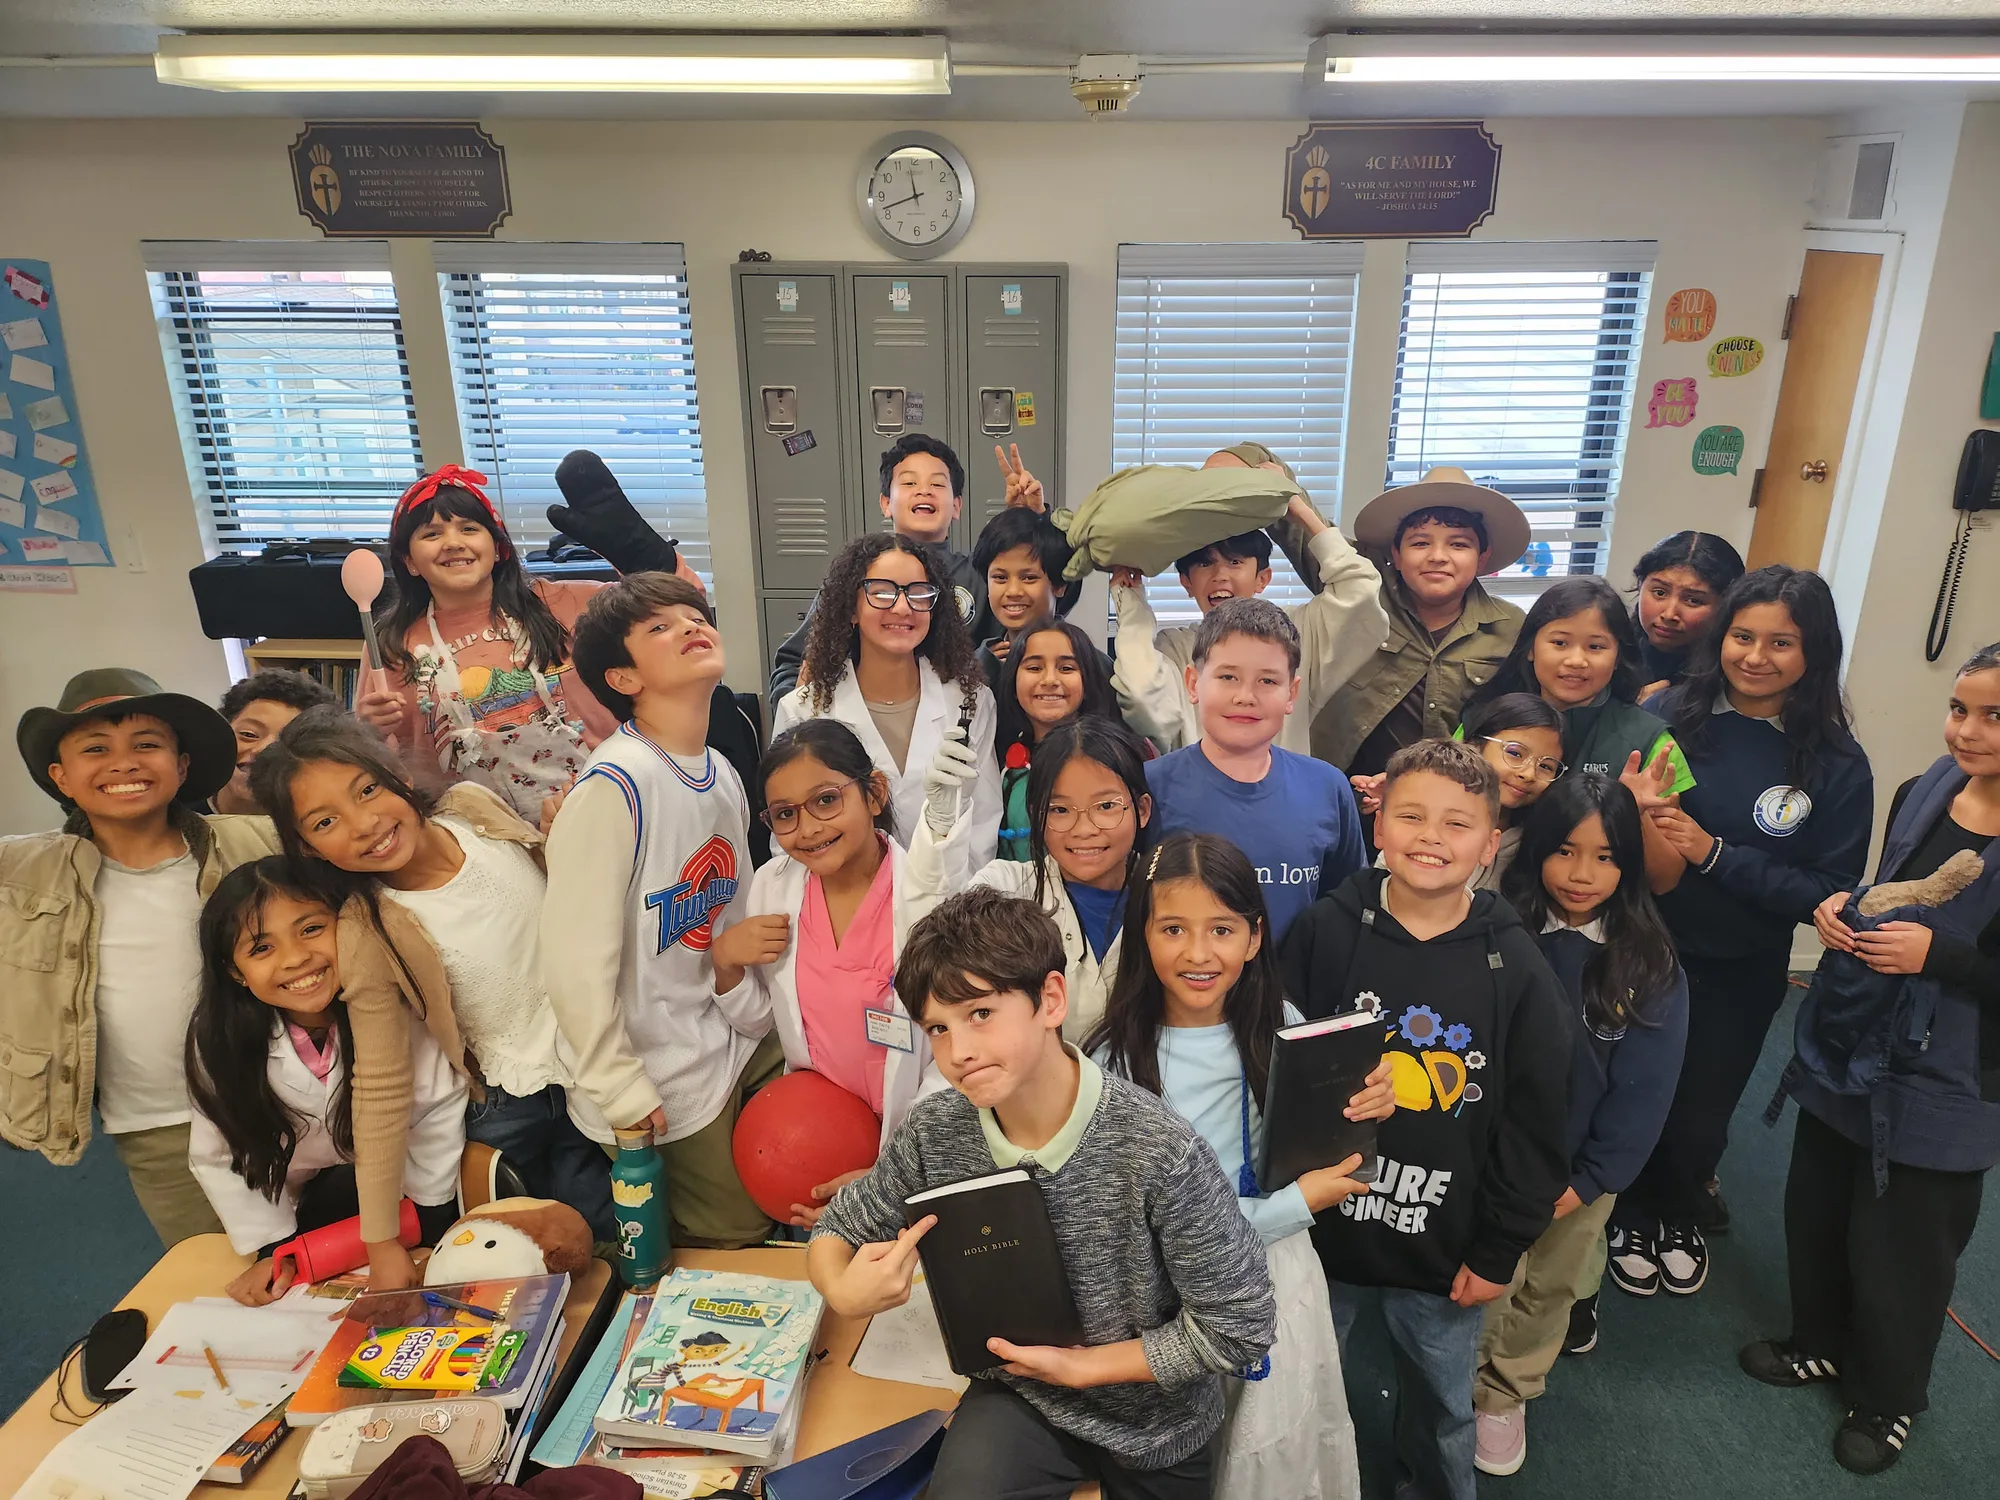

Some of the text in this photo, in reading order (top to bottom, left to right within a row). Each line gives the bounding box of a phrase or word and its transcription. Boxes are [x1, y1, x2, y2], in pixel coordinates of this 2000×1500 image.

[341, 144, 485, 158] THE NOVA FAMILY
[894, 160, 902, 171] 11
[929, 160, 934, 170] 1
[1365, 154, 1456, 170] 4C FAMILY
[883, 172, 893, 184] 10
[940, 171, 947, 183] 2
[1358, 181, 1377, 189] FOR
[1378, 181, 1391, 189] ME
[1393, 181, 1412, 189] AND
[1413, 180, 1428, 189] MY
[1462, 179, 1478, 188] WE
[359, 189, 393, 197] RESPECT
[878, 191, 885, 202] 9
[946, 190, 953, 202] 3
[1354, 192, 1378, 200] WILL
[1378, 192, 1408, 200] SERVE
[1409, 191, 1427, 200] THE
[1381, 203, 1416, 211] JOSHUA
[1417, 202, 1439, 210] 24:15
[388, 210, 415, 218] THANK
[884, 209, 892, 220] 8
[941, 209, 949, 220] 4
[897, 221, 904, 232] 7
[914, 226, 921, 237] 6
[930, 221, 937, 232] 5
[780, 287, 791, 300] 15
[1006, 290, 1018, 303] 16
[1681, 291, 1706, 314] YOU
[1716, 338, 1755, 355] CHOOSE
[1656, 405, 1692, 424] YOU
[1700, 434, 1742, 452] YOU ARE
[1697, 452, 1735, 468] ENOUGH
[1280, 862, 1320, 884] love
[1369, 1155, 1452, 1207] URE
[1339, 1192, 1429, 1234] GINEER
[963, 1239, 1020, 1256] HOLY BIBLE
[501, 1287, 518, 1306] THE
[692, 1297, 783, 1320] English 5
[502, 1334, 518, 1347] 12
[362, 1347, 379, 1359] 12
[380, 1331, 422, 1377] PENCILS
[395, 1328, 436, 1380] COLORED
[253, 1426, 284, 1465] MATH 5
[630, 1471, 688, 1490] Christian School
[668, 1472, 688, 1480] 25-26
[643, 1484, 680, 1498] San Franc
